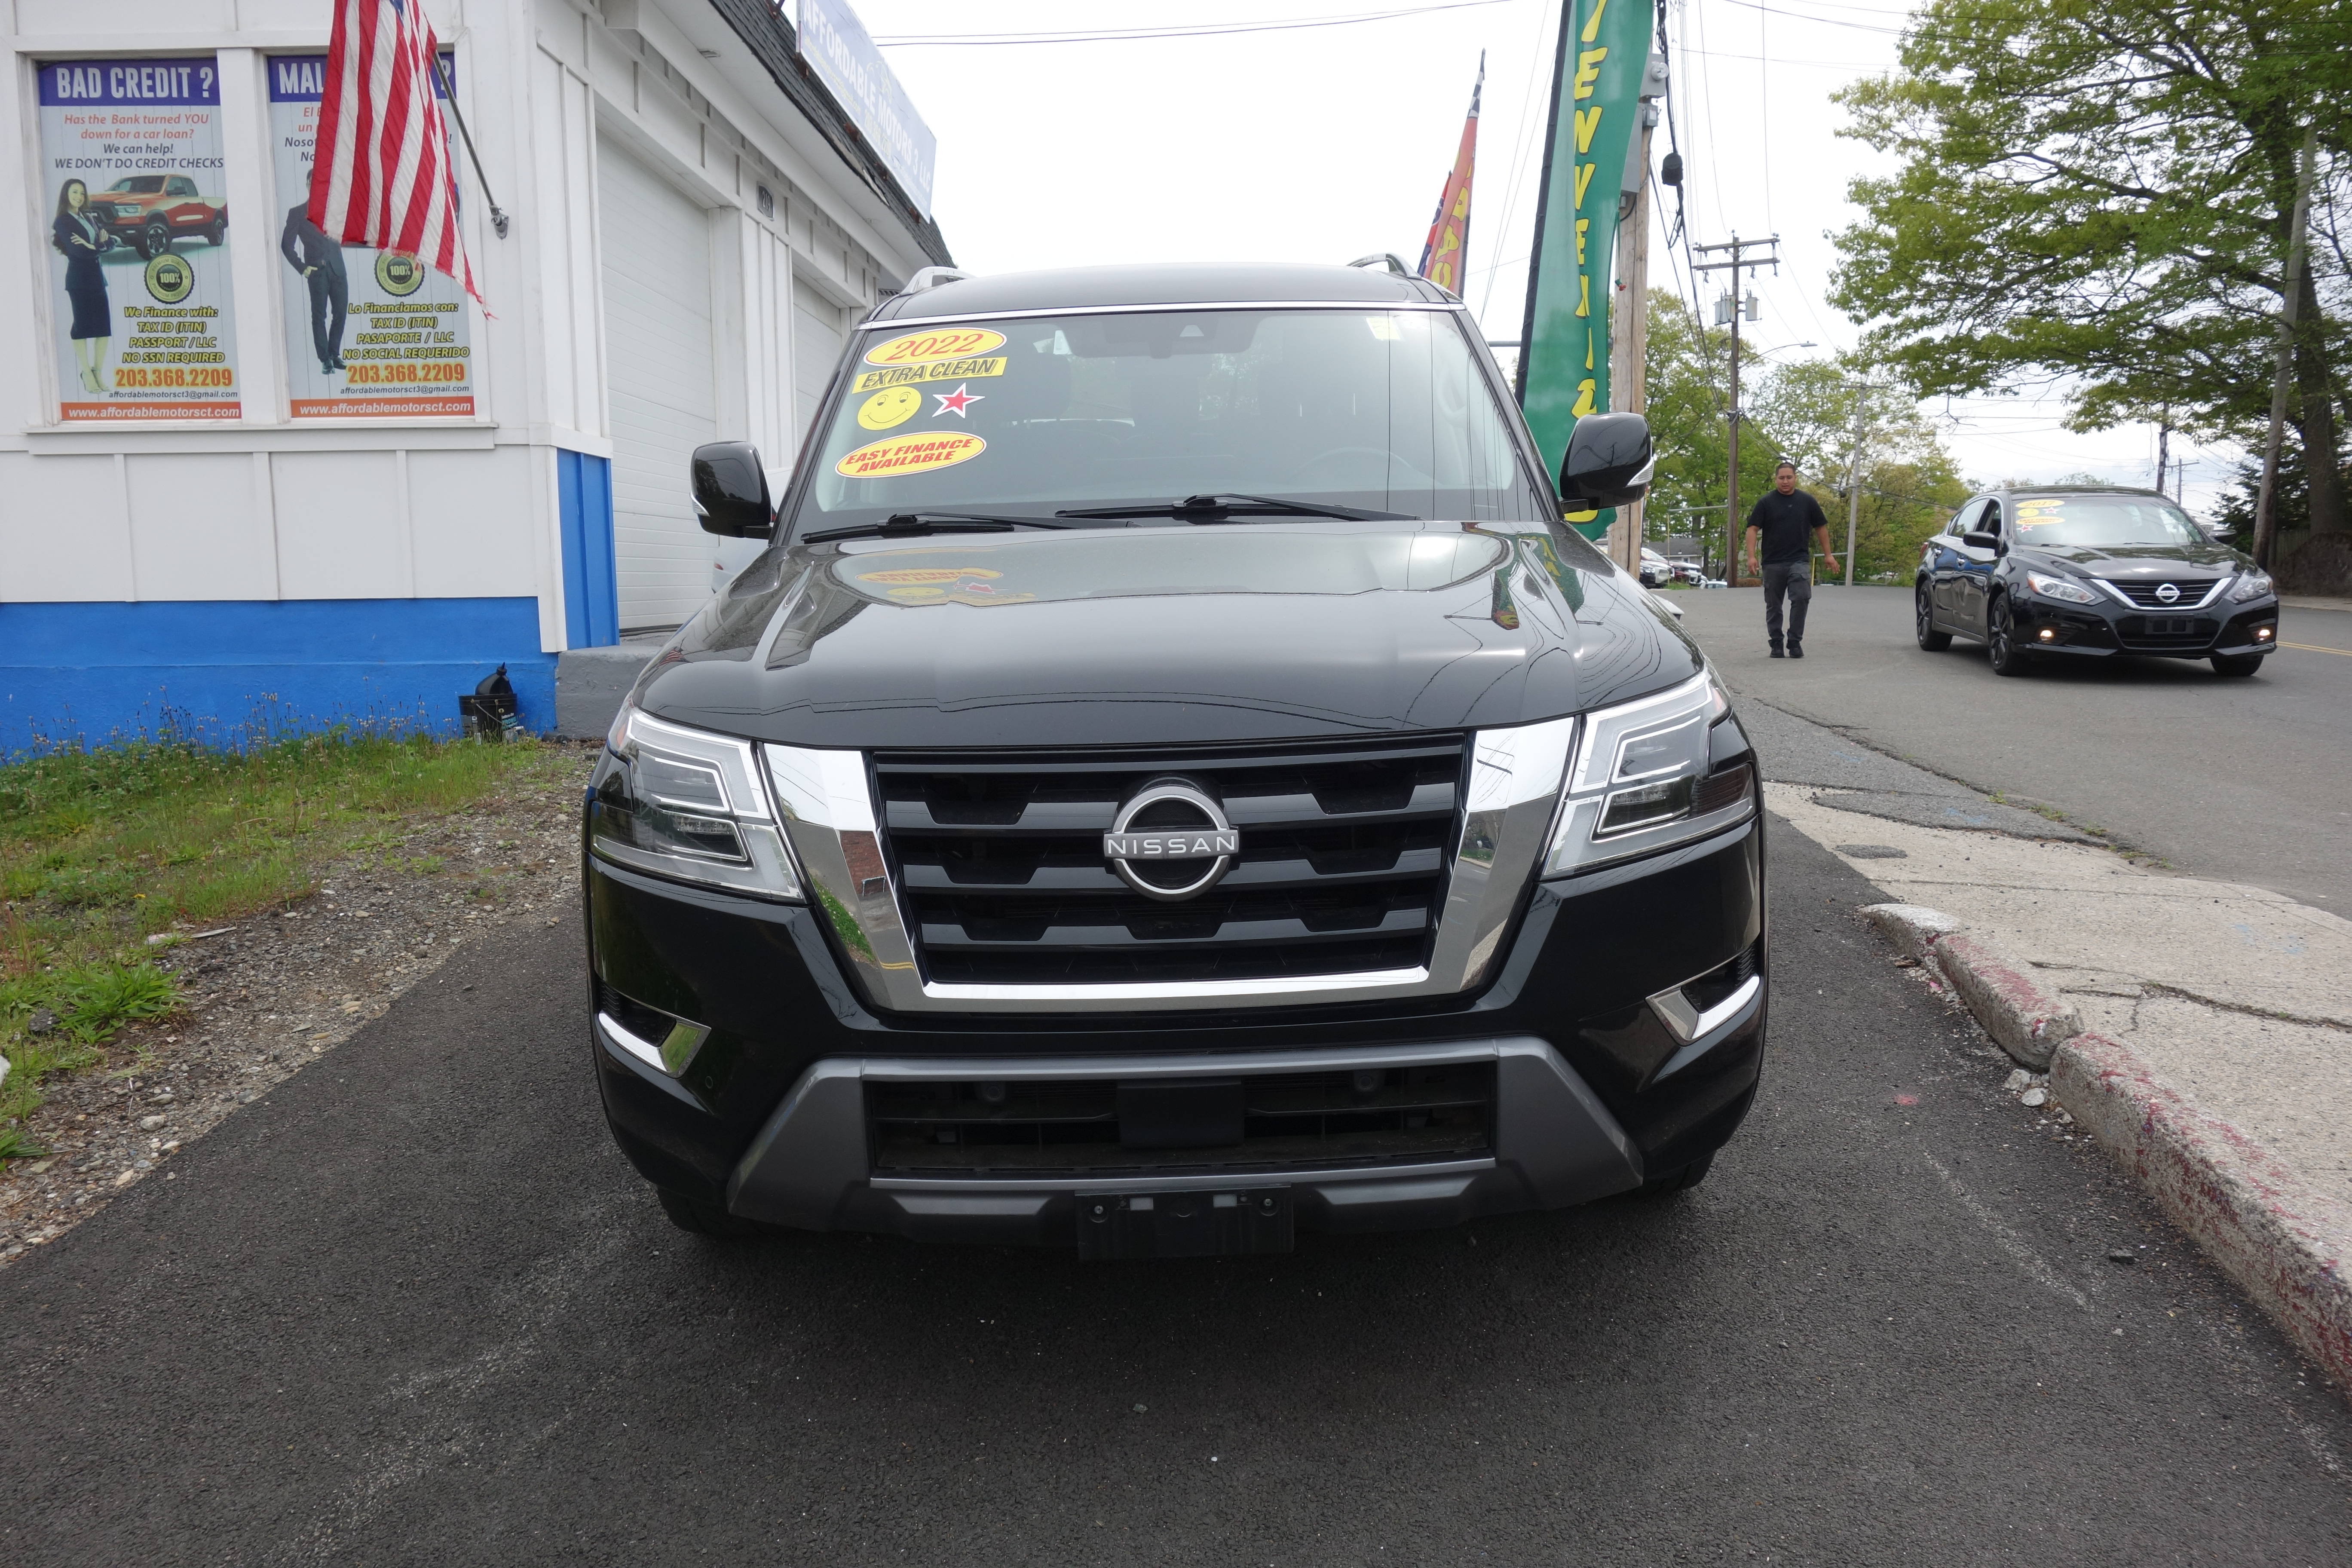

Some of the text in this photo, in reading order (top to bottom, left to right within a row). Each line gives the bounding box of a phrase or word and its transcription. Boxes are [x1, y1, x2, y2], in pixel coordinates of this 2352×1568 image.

[57, 67, 213, 98] BAD CREDIT ?
[279, 63, 324, 93] MAL
[804, 0, 875, 115] AFFORDABLE
[878, 93, 913, 166] MOTORS
[913, 147, 919, 176] 3
[919, 160, 931, 193] LLC
[303, 107, 314, 117] El
[64, 113, 209, 125] Has the Bank turned YOU
[81, 129, 111, 139] down
[114, 129, 131, 139] for
[163, 129, 194, 139] loan?
[285, 137, 316, 147] Noso
[104, 144, 120, 153] We
[145, 143, 174, 156] help!
[55, 158, 224, 168] WE DON'T DO CREDIT CHECKS
[390, 265, 410, 276] 100%
[159, 273, 180, 283] 100%
[124, 306, 218, 317] We Finance with:
[348, 303, 459, 314] Lo Financiamos con:
[138, 322, 206, 334] TAX ID (ITIN)
[371, 317, 438, 329] TAX ID (ITIN)
[129, 337, 217, 348] PASSPORT / LLC
[356, 332, 454, 344] PASAPORTE / LLC
[343, 346, 470, 360] NO SOCIAL REQUERIDO
[884, 334, 983, 361] 2022
[122, 352, 225, 363] NO SSN REQUIRED
[115, 368, 233, 387] 203.368.2209
[347, 363, 465, 383] 203.368.2209
[861, 358, 998, 389] EXTRA CLEAN
[109, 390, 238, 399] affordablemotorsct3@gmail.com
[340, 385, 469, 395] affordablemotorsct3@gmail.com
[69, 406, 239, 417] www.affordablemotorsct.com
[300, 401, 471, 414] www.affordablemotorsct.com
[845, 438, 975, 465] EASY FINANCE
[856, 451, 956, 473] AVAILABLE
[1108, 835, 1235, 854] NISSAN
